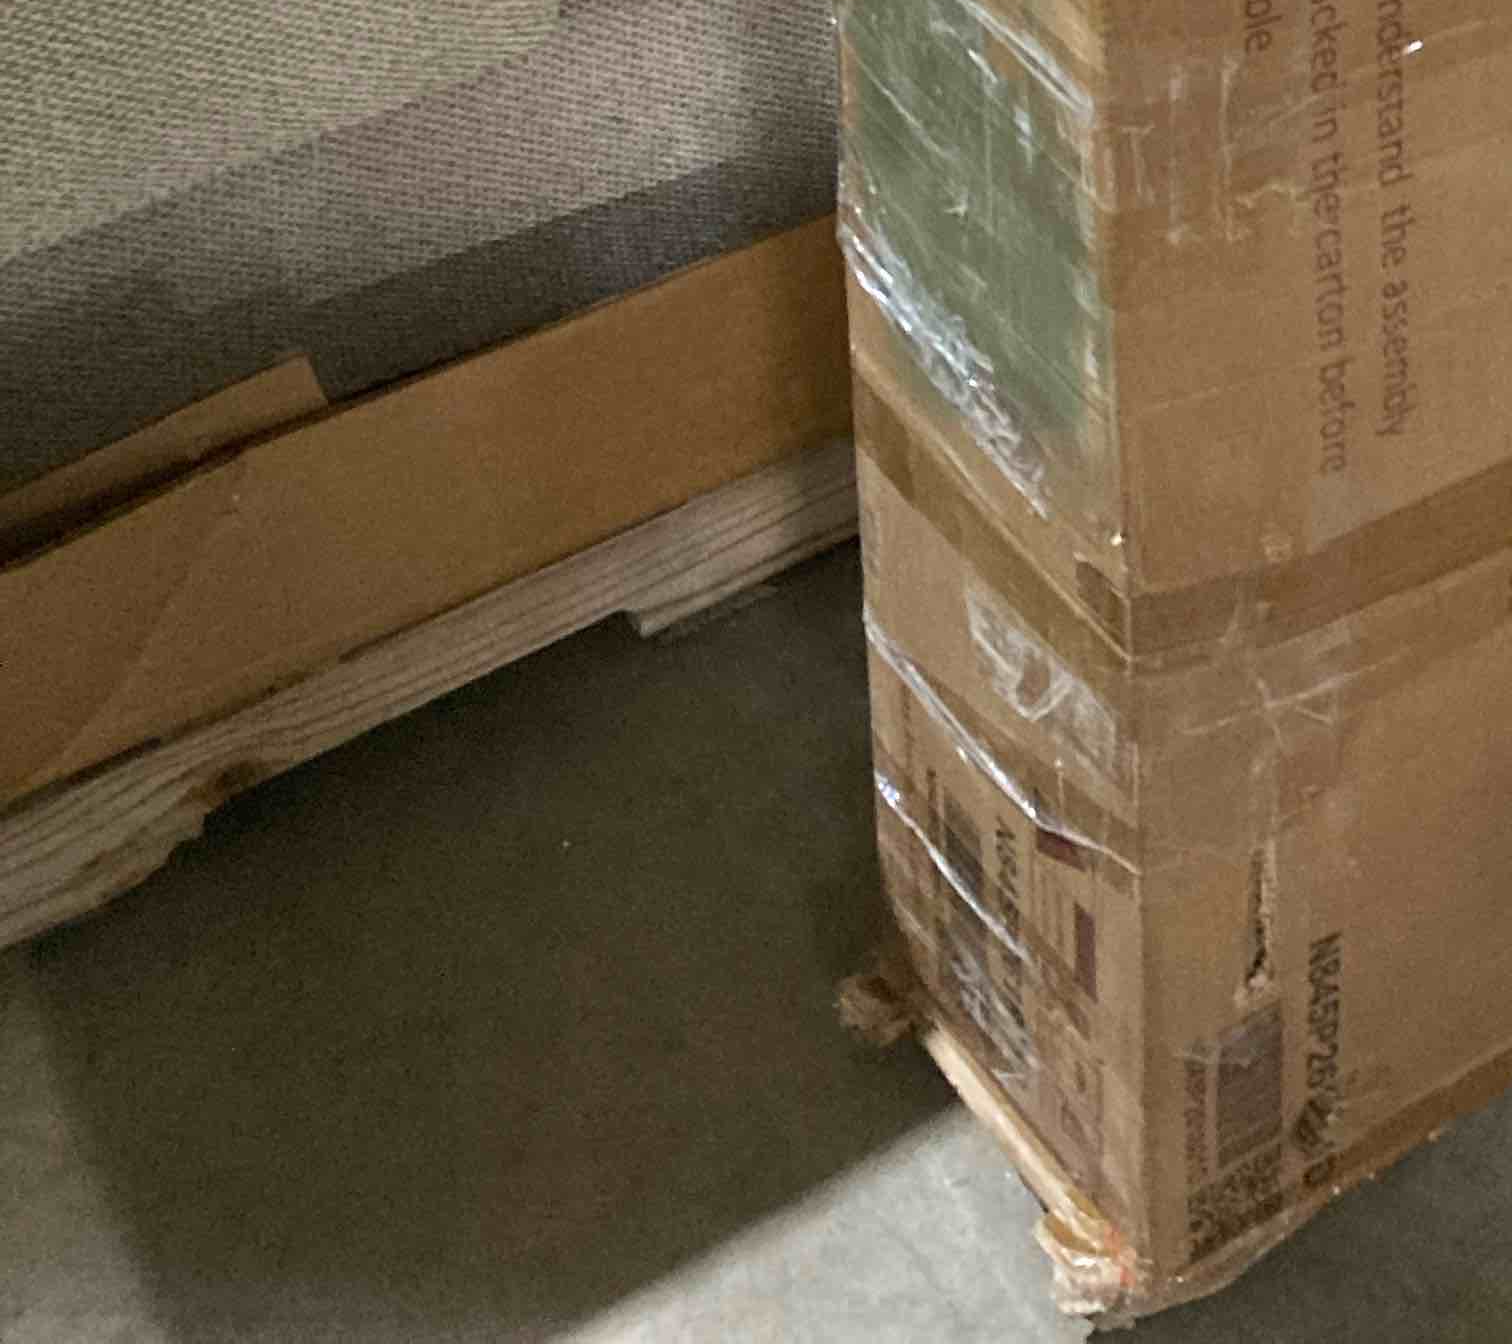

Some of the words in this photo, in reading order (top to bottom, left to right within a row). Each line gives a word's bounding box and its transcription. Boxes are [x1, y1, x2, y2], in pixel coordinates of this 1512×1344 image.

[1311, 105, 1345, 144] in
[1313, 227, 1348, 352] carton
[1379, 204, 1415, 271] the
[1318, 359, 1356, 475] before
[1376, 280, 1418, 438] assembly
